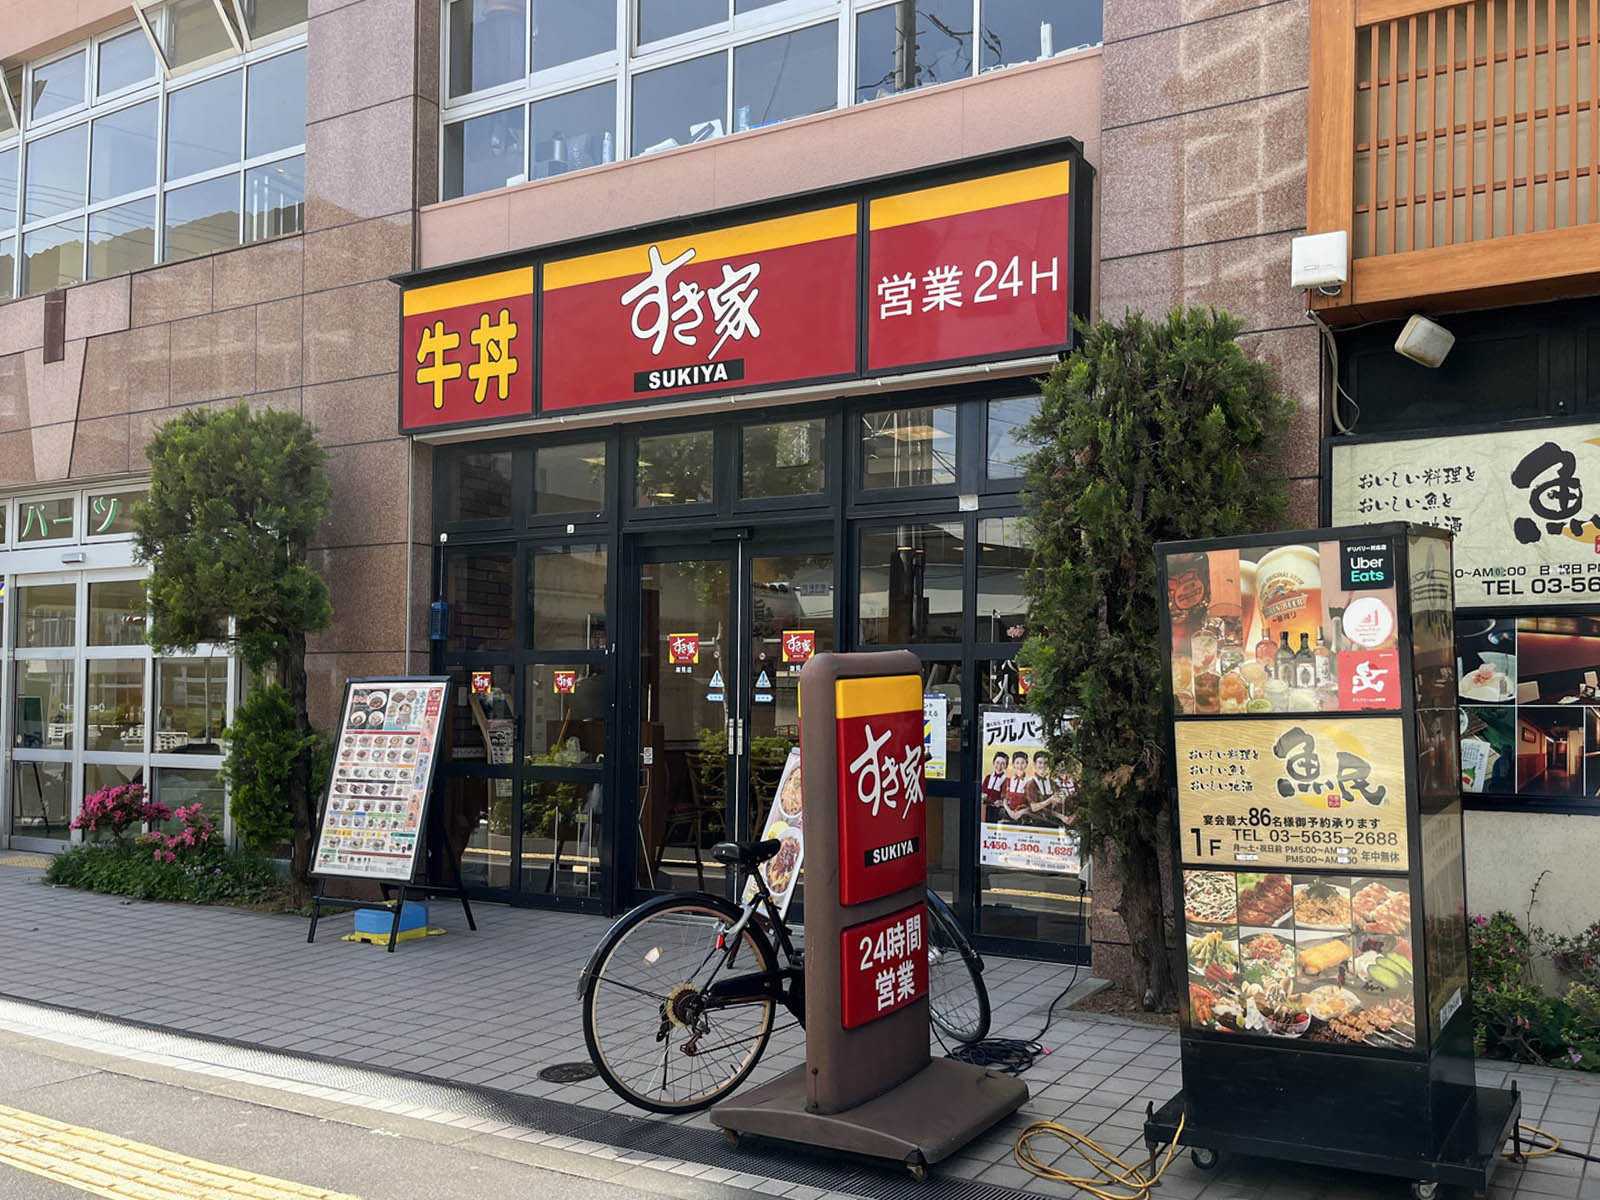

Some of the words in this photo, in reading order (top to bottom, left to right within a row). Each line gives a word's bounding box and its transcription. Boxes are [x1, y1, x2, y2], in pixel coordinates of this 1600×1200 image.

[876, 266, 964, 320] 営業
[974, 254, 1058, 304] 24H
[620, 246, 761, 360] すき家
[416, 308, 518, 410] 牛丼
[648, 362, 729, 389] SUKIYA
[1358, 466, 1477, 489] おいしい料理と
[1358, 492, 1452, 514] おいしい魚と
[1350, 556, 1384, 569] Uber
[1351, 570, 1384, 582] Eats
[1482, 580, 1524, 596] TEL
[1189, 749, 1259, 760] おいしい料理と
[849, 724, 924, 820] すき家
[1190, 764, 1246, 776] おいしい魚と
[1272, 726, 1386, 806] 魚民
[1191, 780, 1253, 792] おいしい地酒
[1203, 808, 1381, 828] 宴会最大86名様御予約承ります
[1232, 828, 1264, 842] TEL
[1269, 830, 1398, 846] 03-5635-2688
[872, 840, 914, 864] SUKIYA
[1361, 850, 1400, 862] 年中無休
[860, 913, 922, 972] 24時間
[874, 960, 916, 1012] 営業
